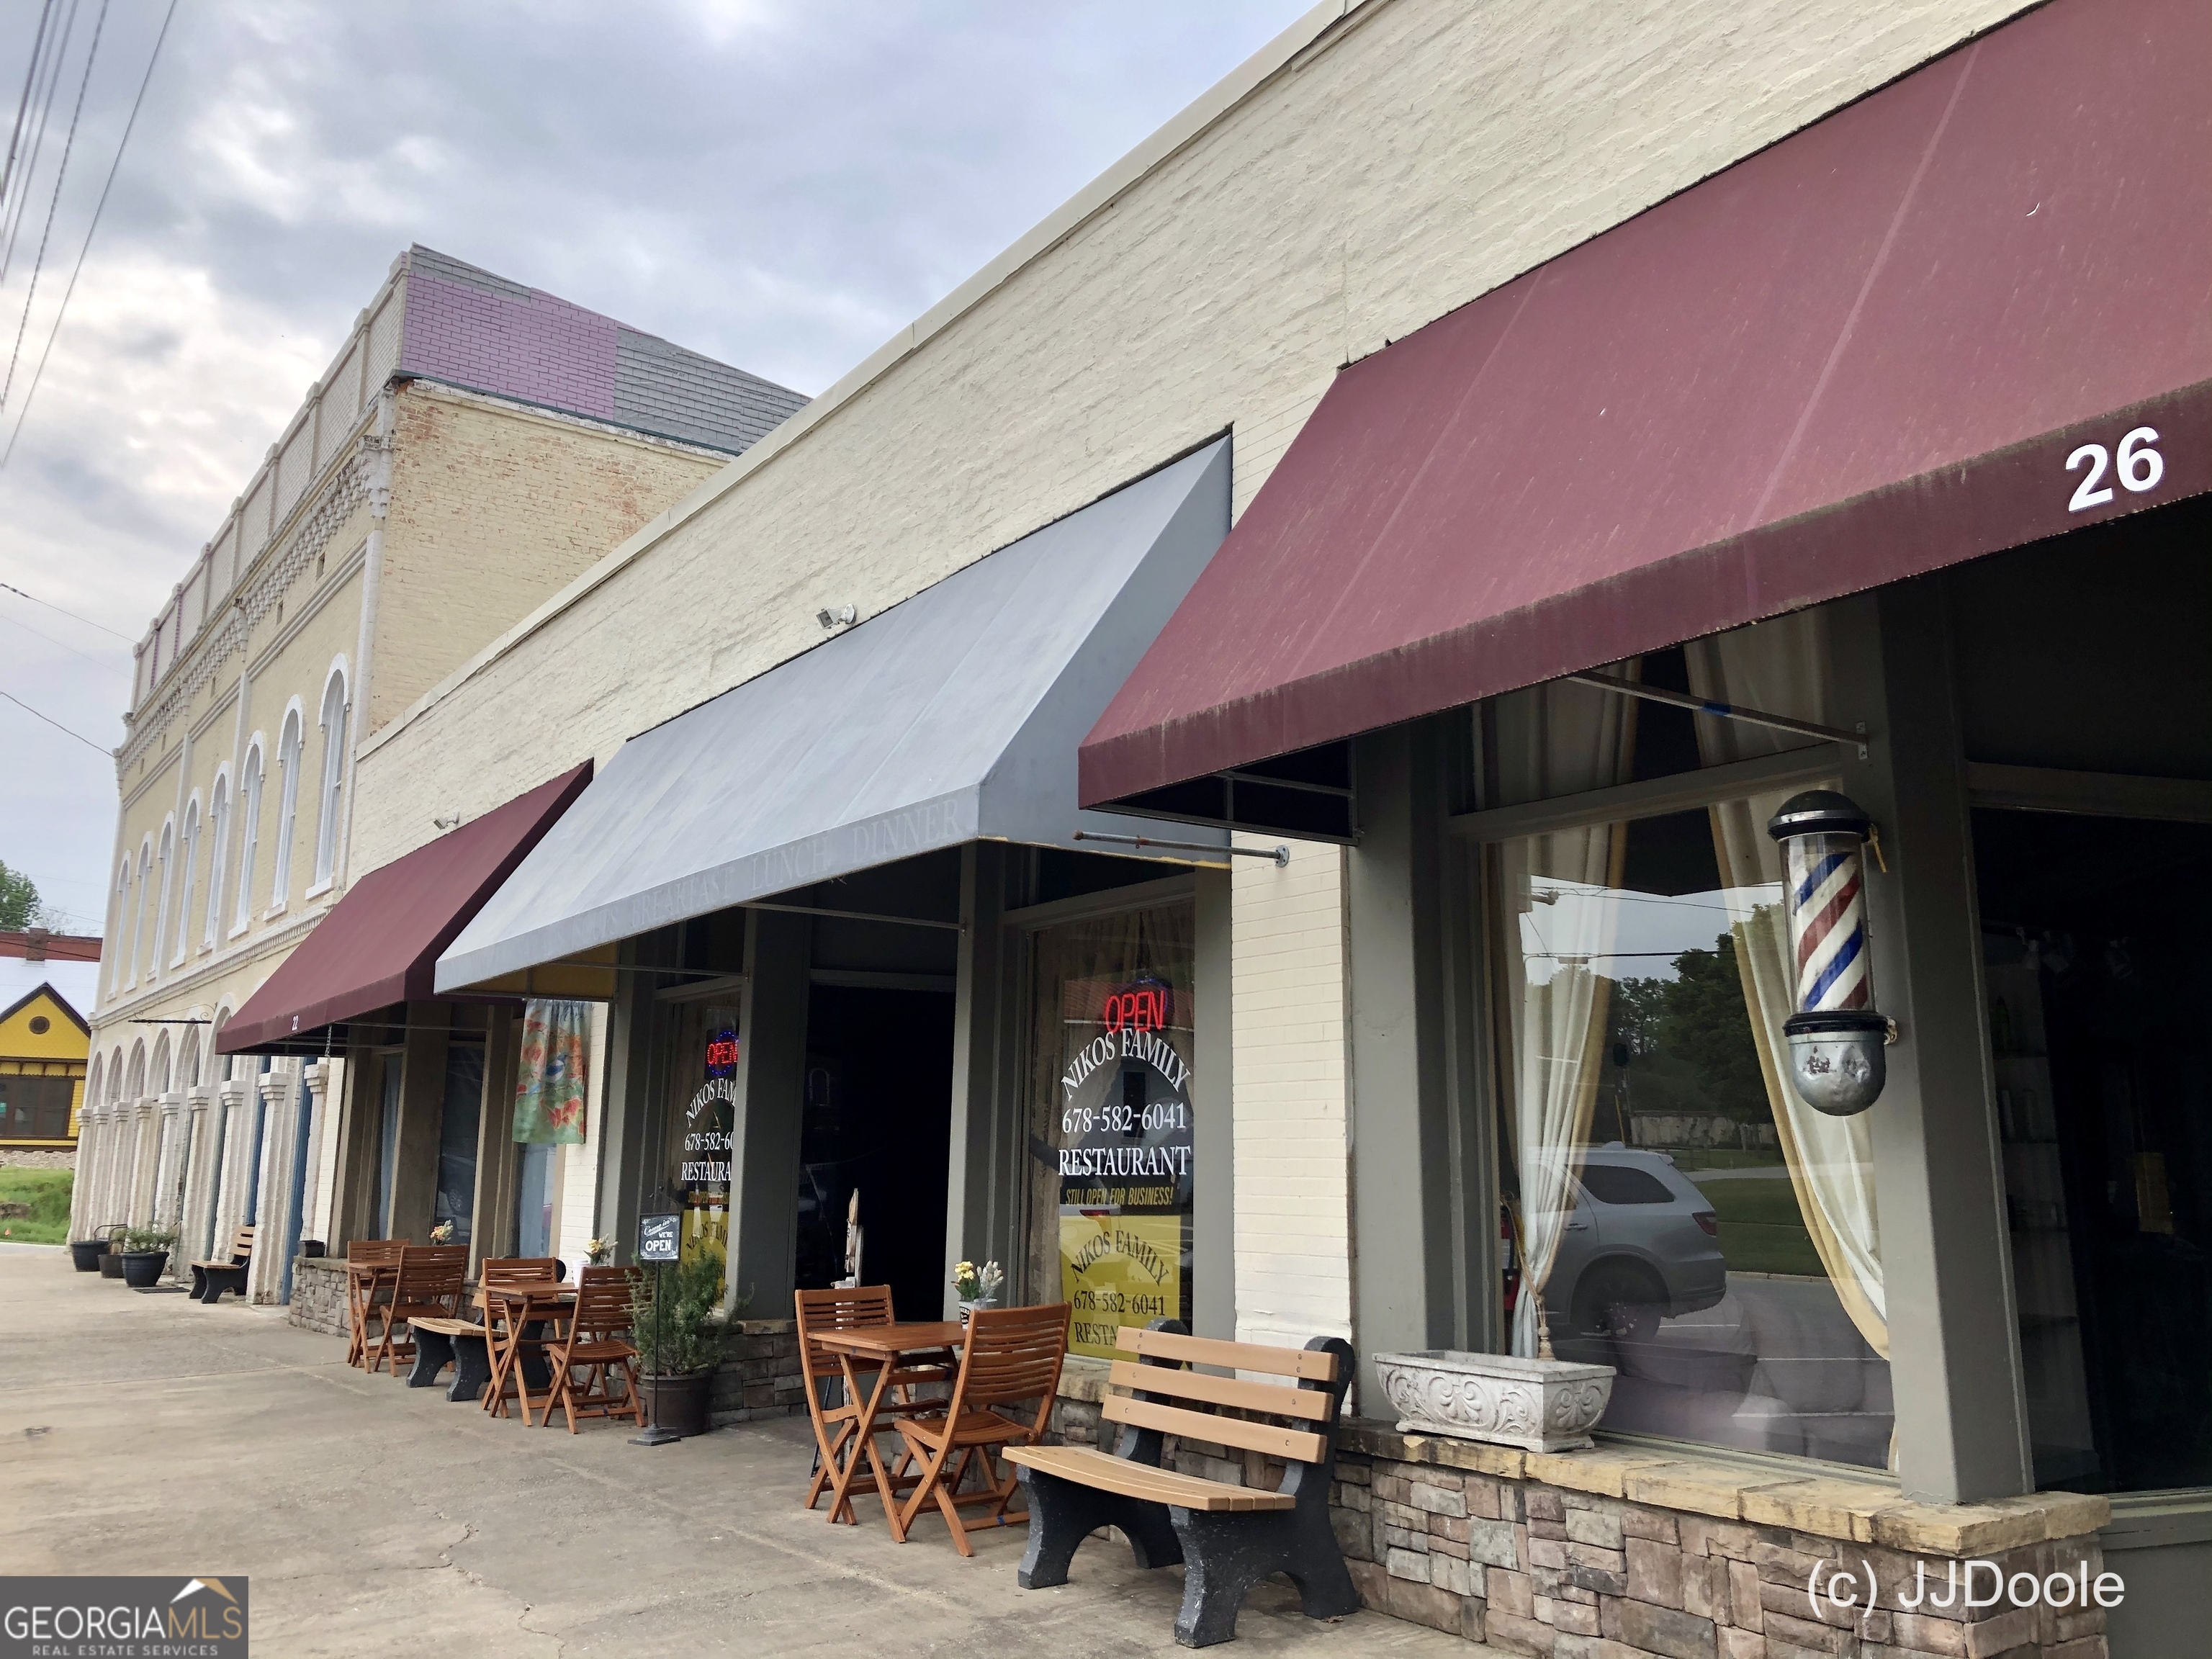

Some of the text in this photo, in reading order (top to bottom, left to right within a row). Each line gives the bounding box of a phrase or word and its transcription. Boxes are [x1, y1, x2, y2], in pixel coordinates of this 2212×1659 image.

[2065, 426, 2164, 512] 26
[750, 837, 830, 891] LUNCH
[852, 799, 960, 860] DINNER
[292, 1015, 299, 1031] 22
[1105, 990, 1165, 1033] OPEN
[706, 1042, 738, 1065] OPEN
[1061, 1028, 1191, 1102] NIKOS FAMILY
[685, 1078, 736, 1129] NIKOS FAM
[1062, 1102, 1187, 1133] 678-582-6041
[685, 1131, 734, 1151] 678-582-60
[680, 1161, 732, 1181] RESTAURA
[1058, 1145, 1191, 1176] RESTAURANT
[1065, 1186, 1174, 1205] STILL OPEN FOR BUSINESS!
[645, 1239, 672, 1252] OPEN
[1070, 1230, 1169, 1287] NIKOS FAMILY
[1074, 1290, 1166, 1316] 678-582-6041
[1074, 1322, 1118, 1346] RESTA
